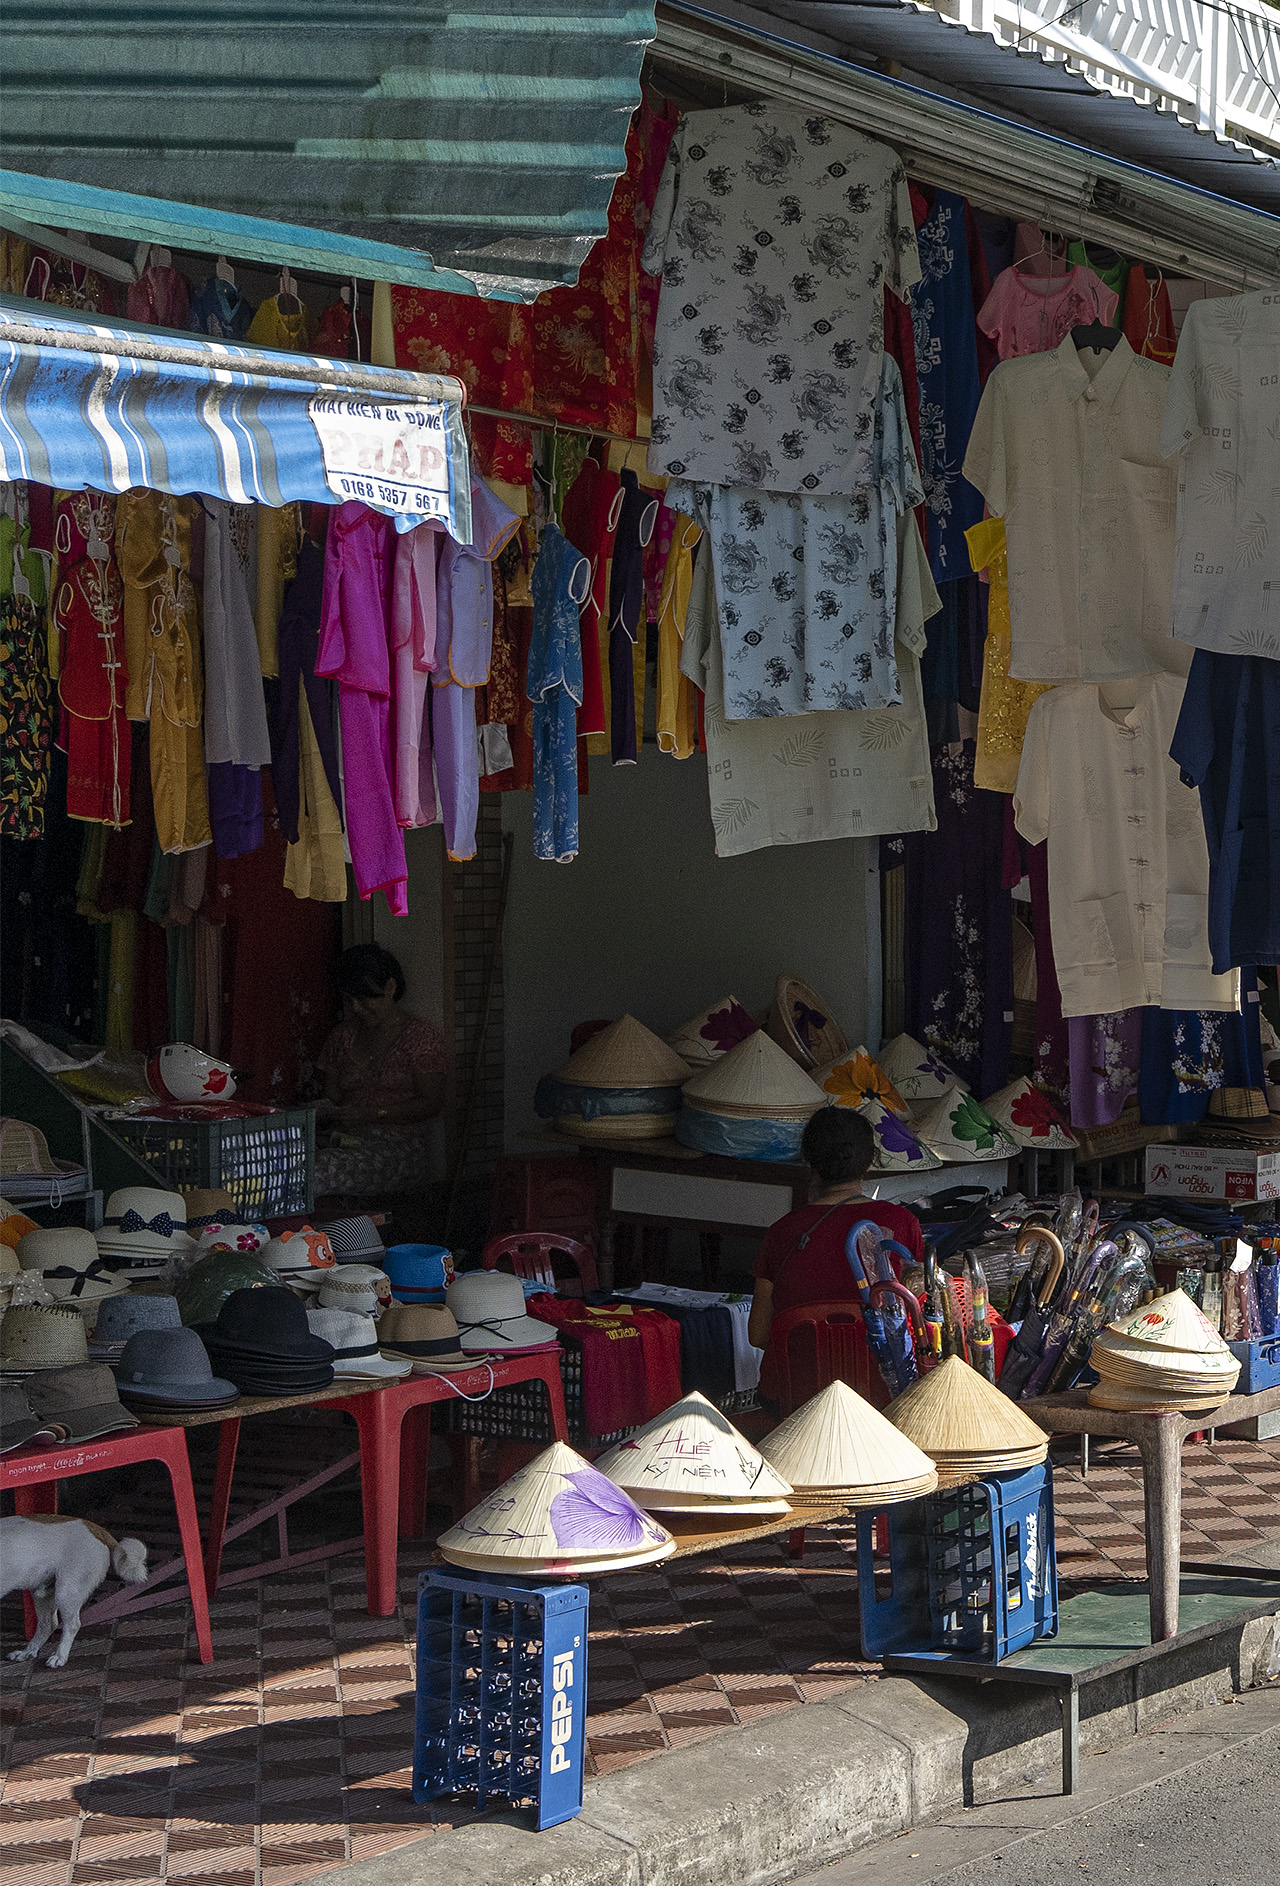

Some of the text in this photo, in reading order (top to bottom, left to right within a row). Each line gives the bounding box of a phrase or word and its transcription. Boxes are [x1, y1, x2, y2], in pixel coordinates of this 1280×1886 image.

[326, 430, 444, 481] PHÁP
[341, 478, 440, 511] 0168 5357 567
[1178, 1175, 1205, 1186] ngon
[1189, 1182, 1215, 1194] ngon
[1228, 1177, 1254, 1185] VIFON
[550, 1650, 574, 1775] PEPSI
